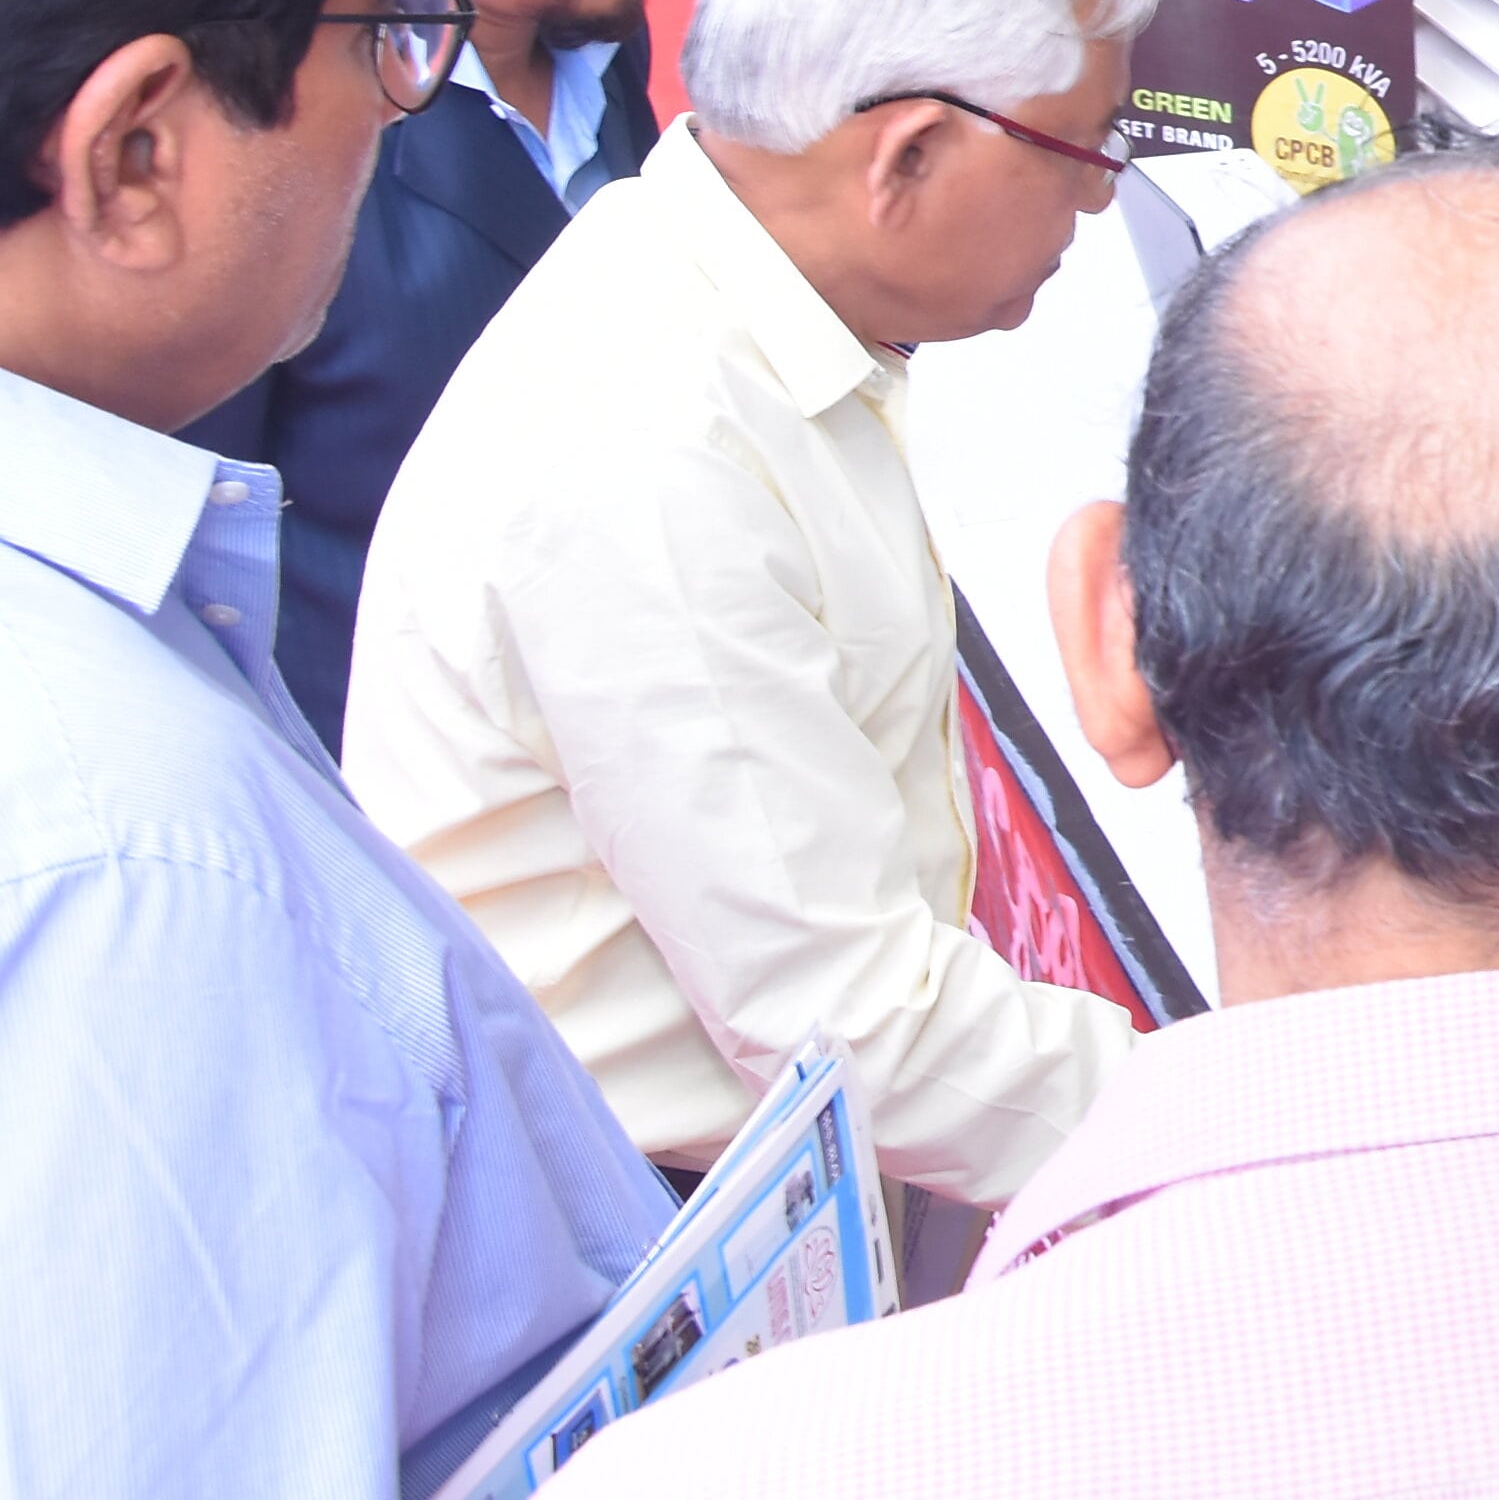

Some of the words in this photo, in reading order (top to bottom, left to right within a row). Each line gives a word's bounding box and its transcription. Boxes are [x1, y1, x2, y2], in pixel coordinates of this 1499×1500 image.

[1255, 52, 1277, 75] 5
[1291, 40, 1346, 68] 5200
[1349, 55, 1392, 98] kVA
[1132, 88, 1232, 124] GREEN
[1161, 125, 1234, 151] BRAND
[1274, 137, 1334, 167] CPCB
